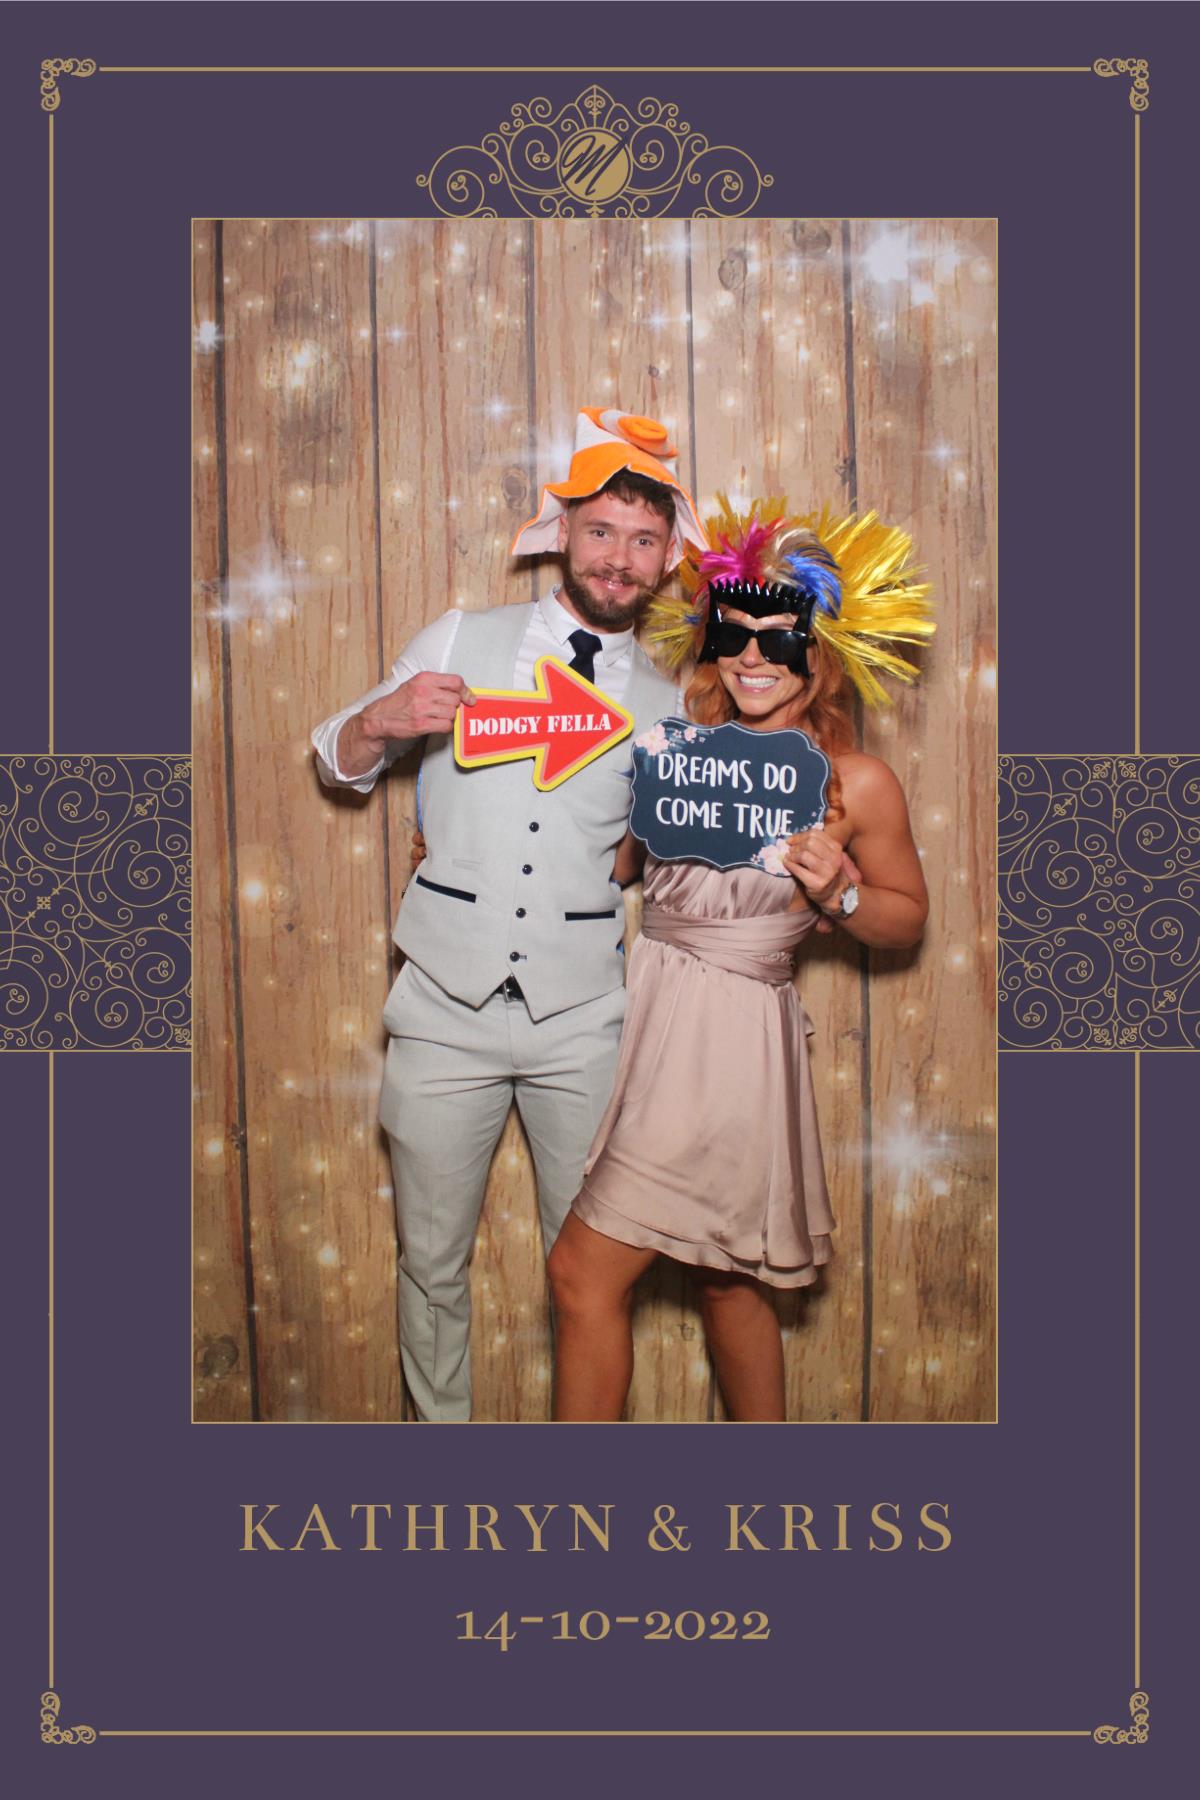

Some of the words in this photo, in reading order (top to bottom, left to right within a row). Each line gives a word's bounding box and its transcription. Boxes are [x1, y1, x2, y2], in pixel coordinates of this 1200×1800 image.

[469, 716, 540, 737] DODGY
[547, 713, 612, 733] FELLA
[657, 753, 752, 794] DREAMS
[763, 763, 797, 794] DO
[656, 797, 723, 829] COME
[733, 803, 795, 838] TRUE
